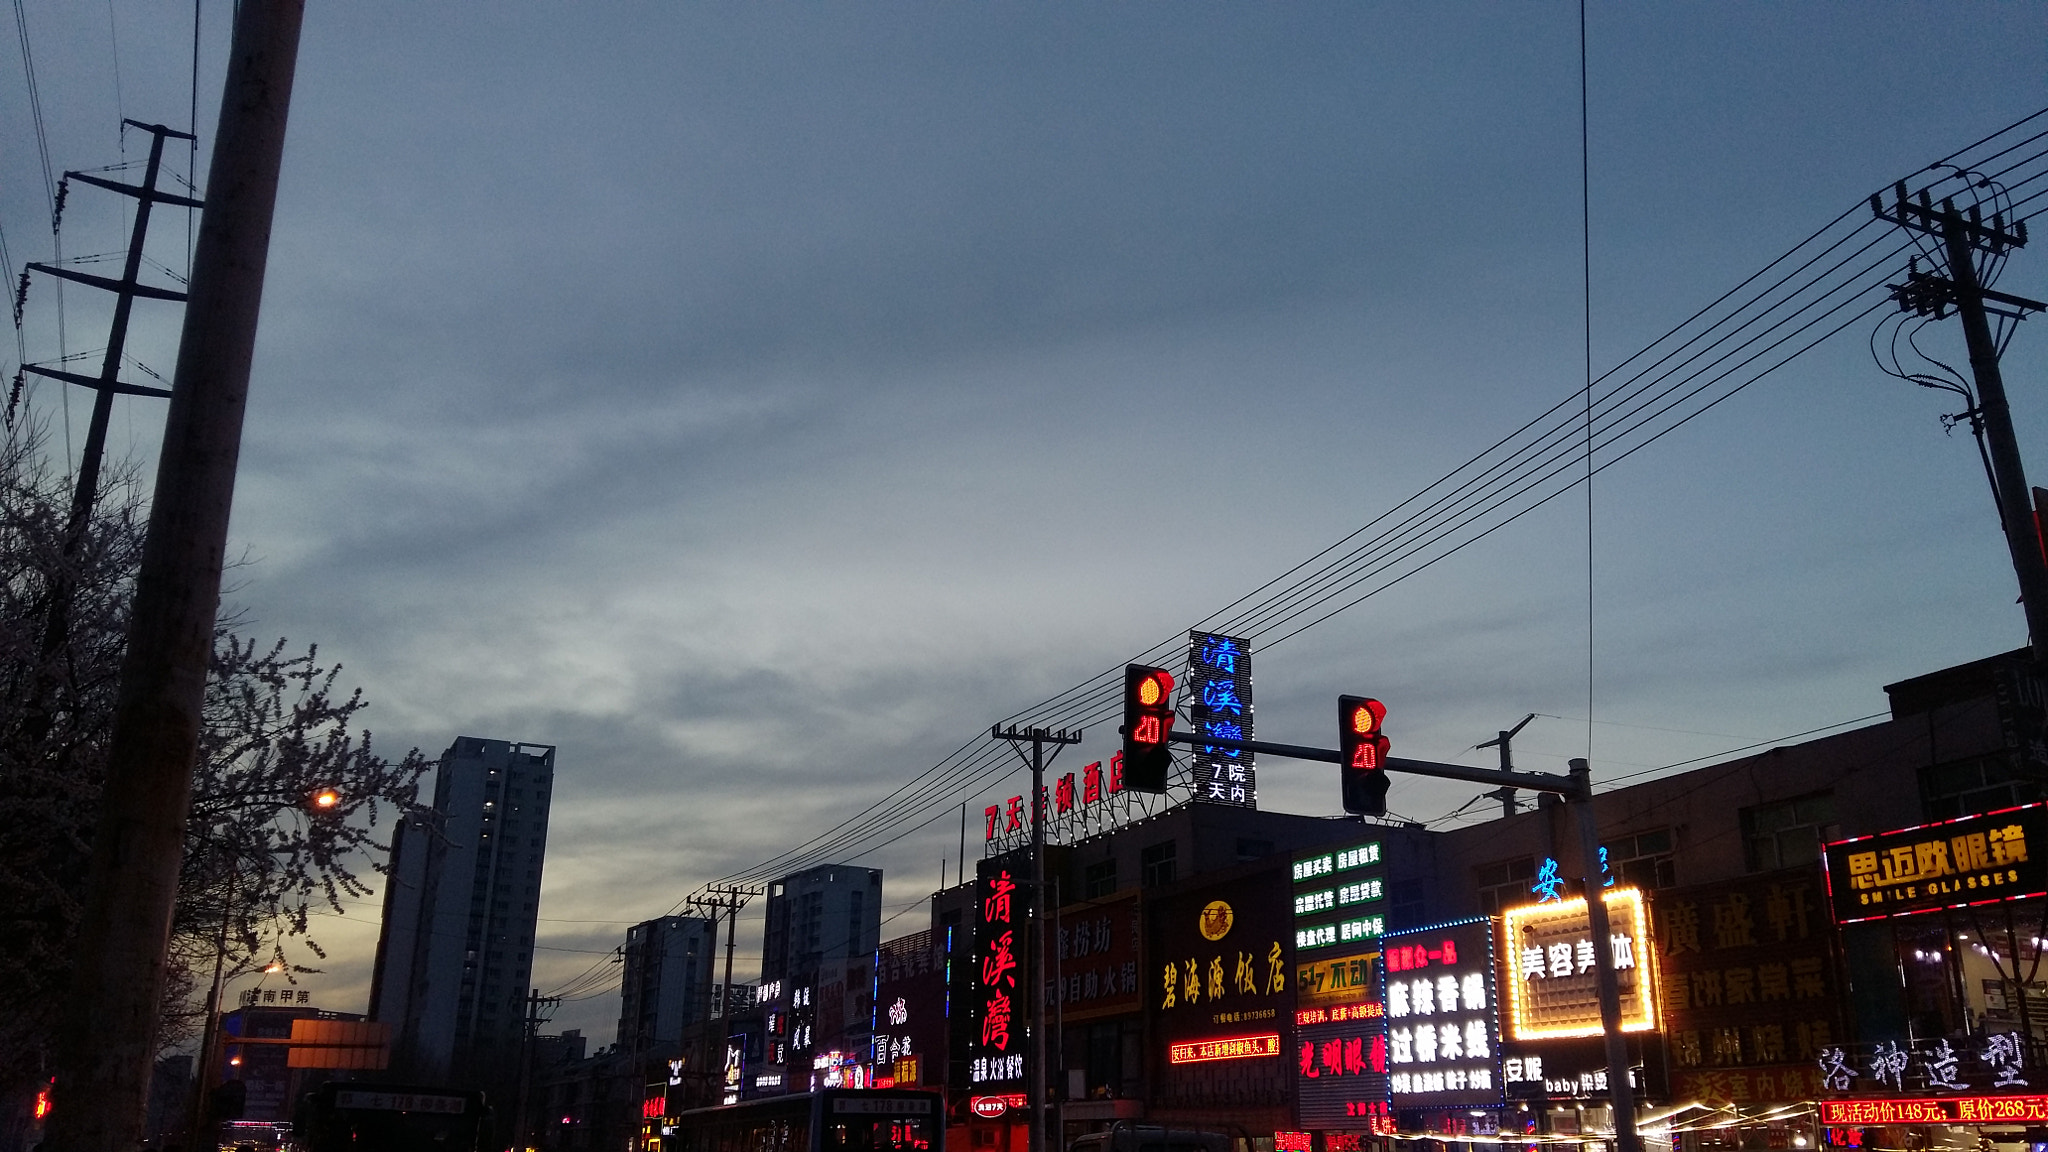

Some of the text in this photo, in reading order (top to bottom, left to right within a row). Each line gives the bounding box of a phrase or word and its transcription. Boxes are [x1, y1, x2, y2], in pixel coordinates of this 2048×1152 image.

[1134, 716, 1159, 744] 20
[1293, 844, 1379, 880] 房屋买卖 房屋租赁
[1848, 824, 2028, 889] 思迈欧眼镜
[1295, 880, 1382, 914] 房屋托管 房屋贷款
[1860, 870, 2018, 905] SMILE GLASSES
[1162, 941, 1285, 1010] 碧海源饭店
[1389, 973, 1486, 1018] 麻辣香锅
[1300, 1034, 1386, 1077] 光明眼镜
[1392, 1019, 1490, 1064] 过桥米线
[1006, 1053, 1023, 1079] 餐饮
[1506, 1057, 1543, 1083] 安妮
[1546, 1078, 1579, 1095] baby
[1819, 1031, 2029, 1093] 洛神造型
[1831, 1098, 2048, 1123] 现活动价148元；原价268元
